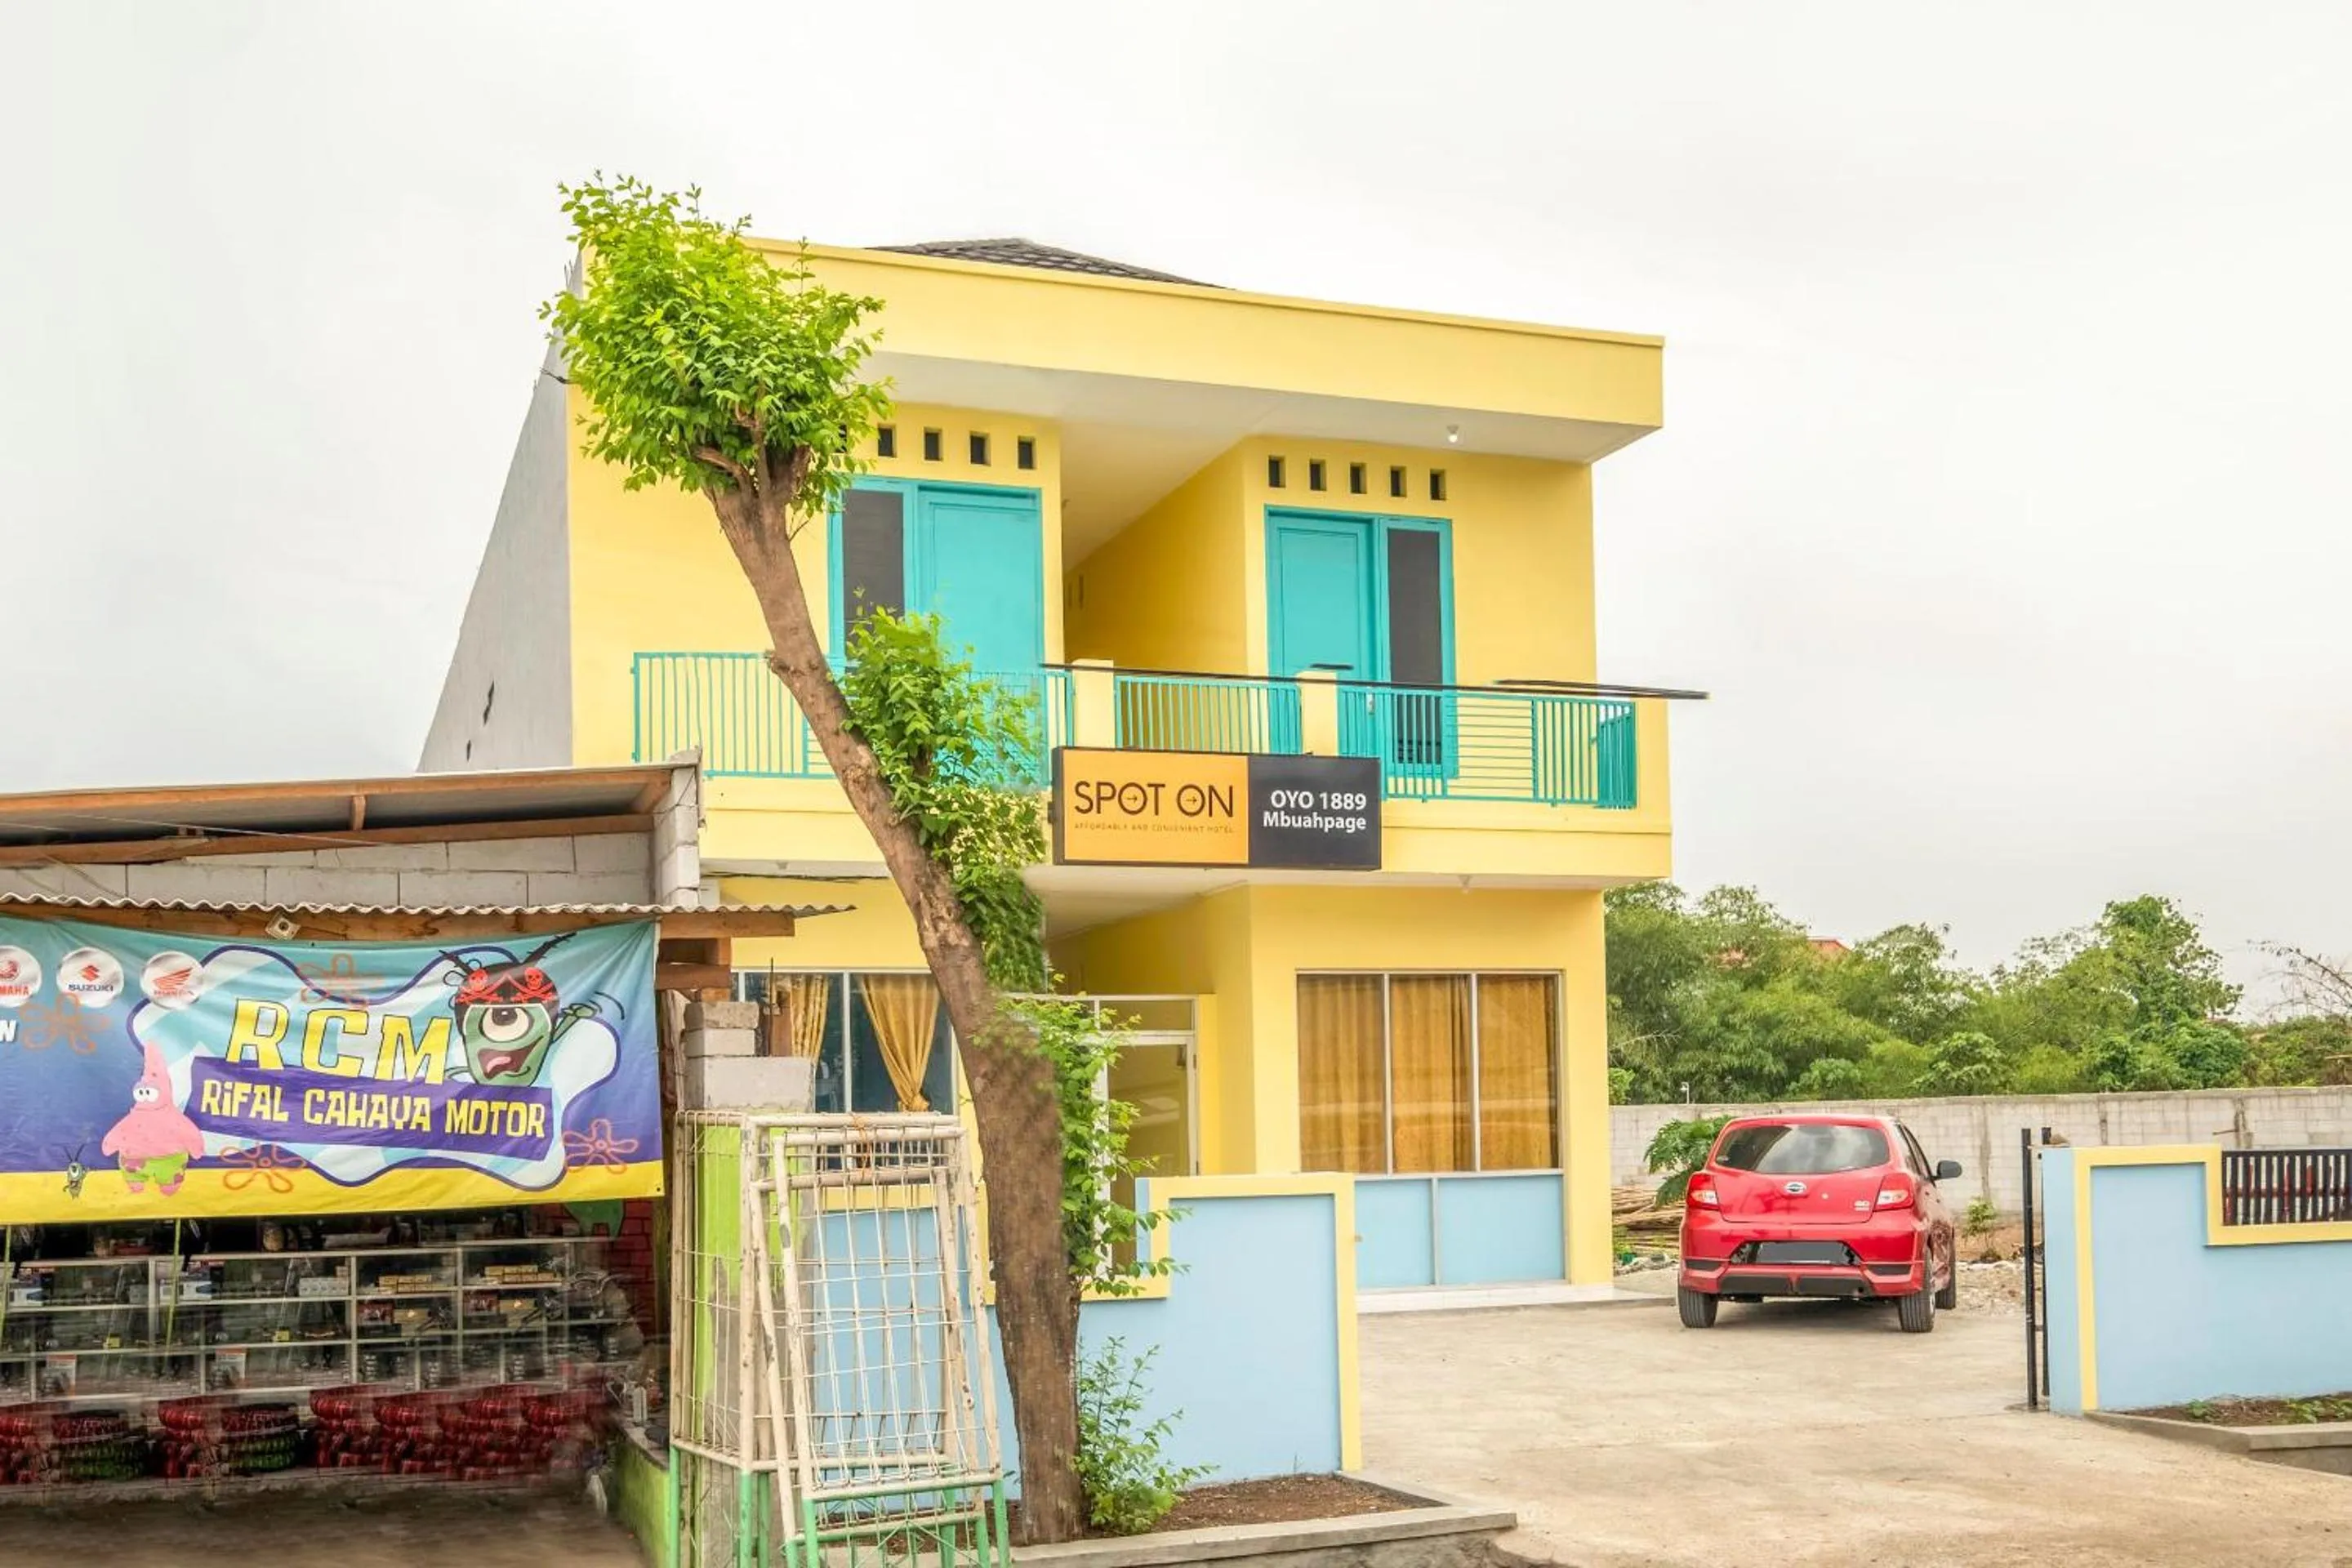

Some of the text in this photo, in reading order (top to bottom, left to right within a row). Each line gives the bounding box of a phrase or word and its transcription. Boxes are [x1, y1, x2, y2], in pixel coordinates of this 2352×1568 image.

[1074, 780, 1234, 817] SPOT ON
[1271, 790, 1366, 810] OYO 1889
[1263, 811, 1366, 833] Mbuahpage
[0, 984, 29, 996] MAHA
[68, 983, 114, 992] SUZUKI
[225, 997, 453, 1085] RCM
[303, 1089, 431, 1132] CAHAYA
[444, 1099, 546, 1138] MOTOR
